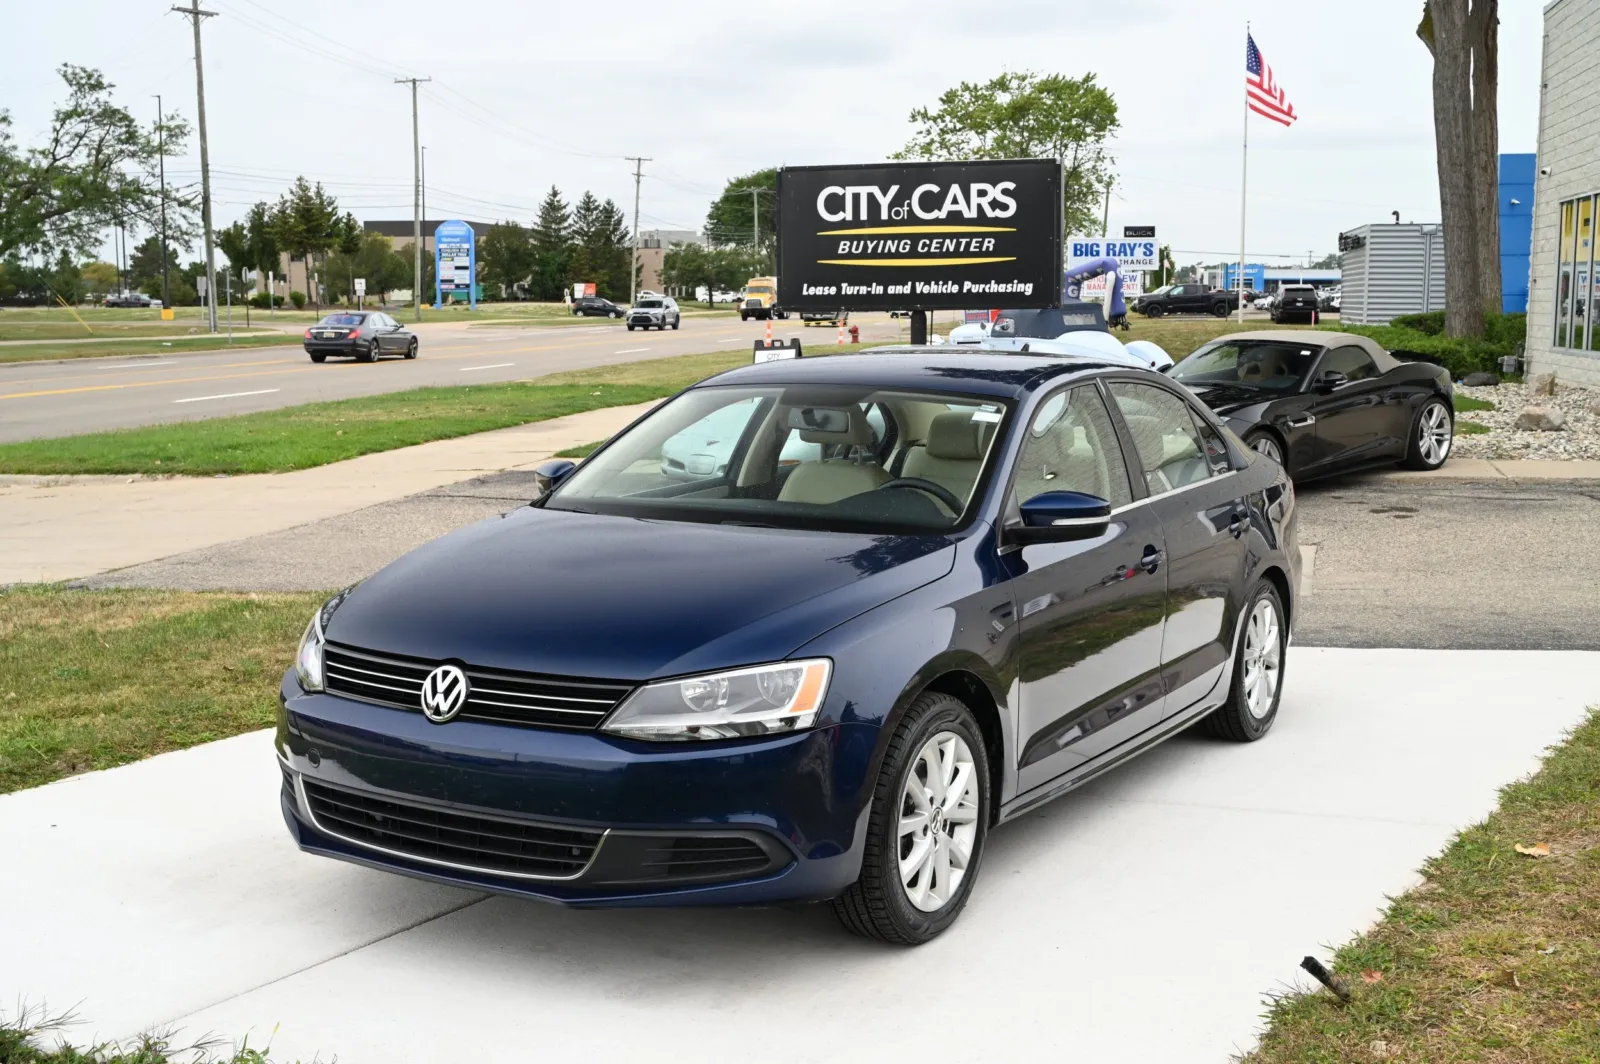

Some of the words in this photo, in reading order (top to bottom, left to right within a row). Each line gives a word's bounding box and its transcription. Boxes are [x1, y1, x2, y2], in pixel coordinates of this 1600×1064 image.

[816, 184, 900, 222] CITY
[891, 200, 910, 220] of
[911, 181, 1017, 220] CARS
[837, 239, 911, 254] BUYING
[917, 237, 996, 253] CENTER
[1073, 243, 1100, 257] BIG
[1106, 243, 1154, 257] RAY'S
[802, 283, 837, 296] Lease
[841, 282, 884, 295] Turn-In
[887, 281, 912, 295] and
[915, 280, 960, 294] Vehicle
[963, 279, 1034, 296] Purchasing
